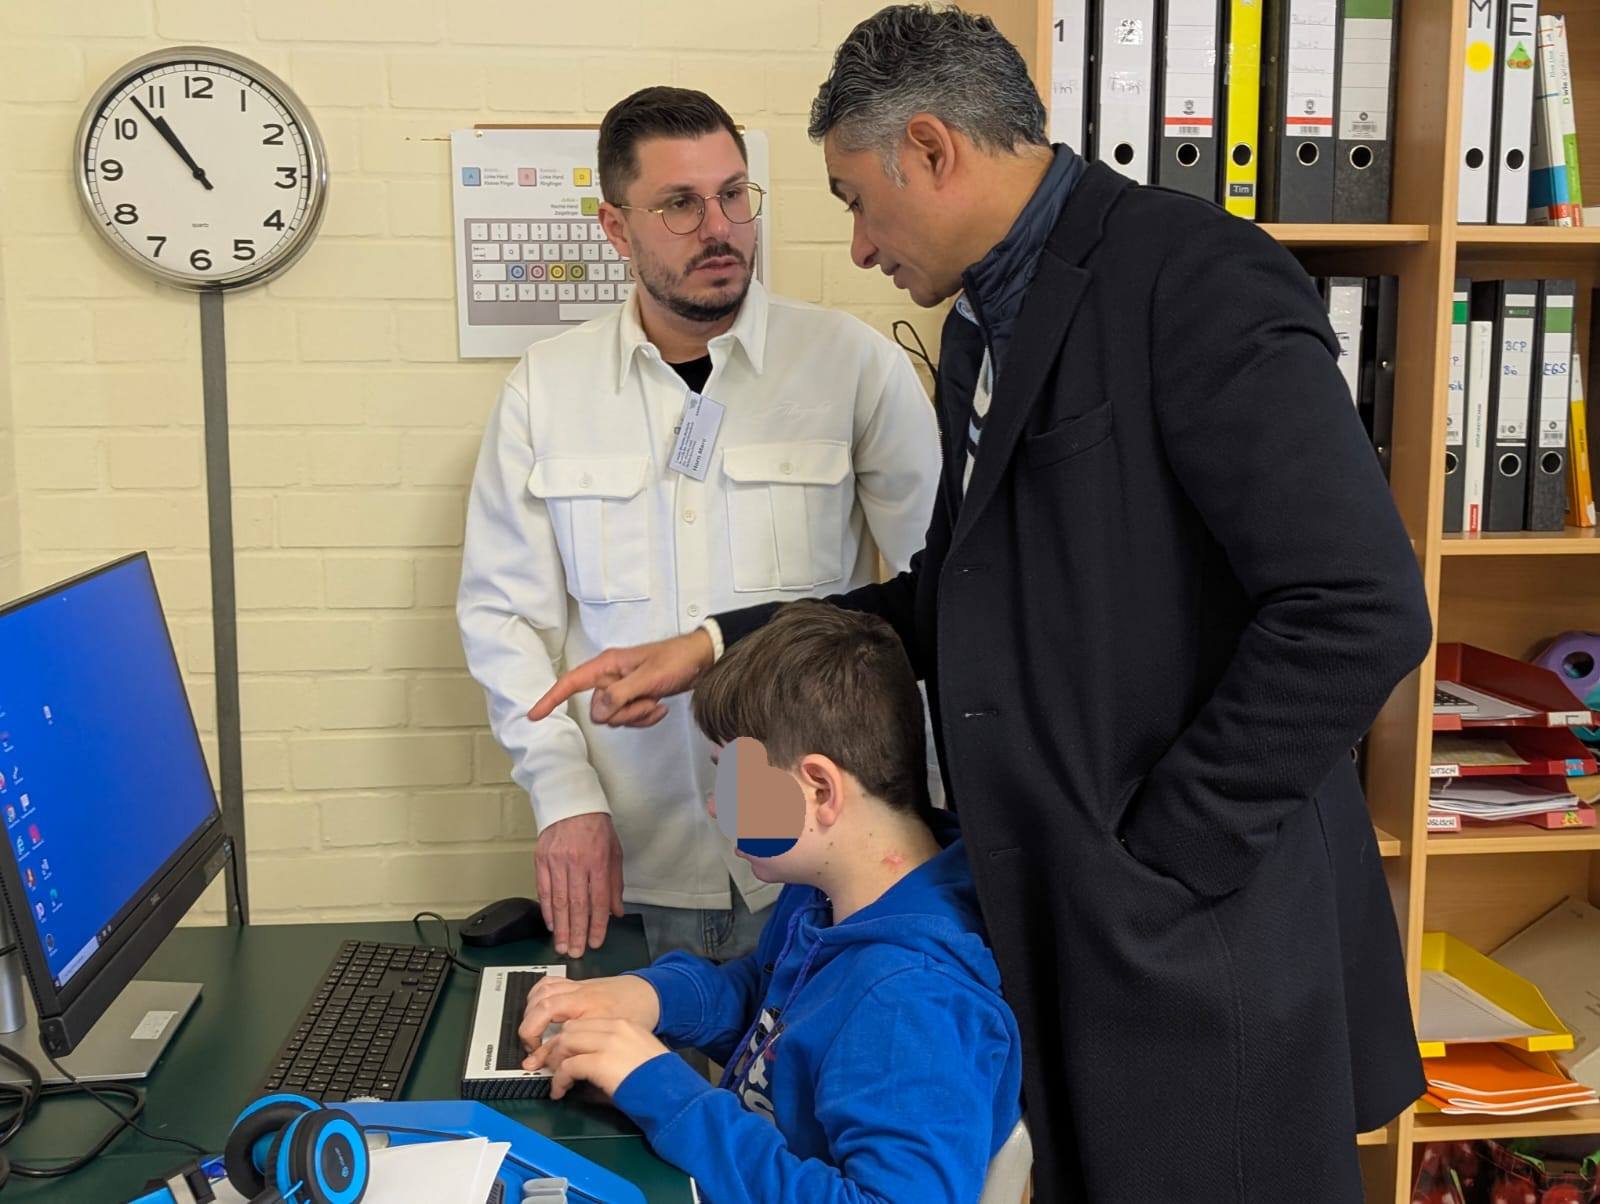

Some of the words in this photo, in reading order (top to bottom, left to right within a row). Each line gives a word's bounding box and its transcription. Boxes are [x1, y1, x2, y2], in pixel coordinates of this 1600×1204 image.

[1468, 0, 1491, 29] M
[1509, 3, 1534, 36] E
[1054, 19, 1065, 42] 1
[148, 85, 165, 108] 11
[184, 75, 214, 99] 12
[240, 89, 246, 112] 1
[114, 118, 138, 140] 10
[262, 123, 285, 145] 2
[100, 159, 124, 182] 9
[274, 166, 298, 189] 3
[1232, 185, 1250, 193] Tim
[113, 203, 139, 225] 8
[263, 209, 285, 231] 4
[146, 236, 168, 257] 7
[232, 239, 256, 261] 5
[189, 249, 212, 271] 6
[1542, 363, 1567, 376] EGS
